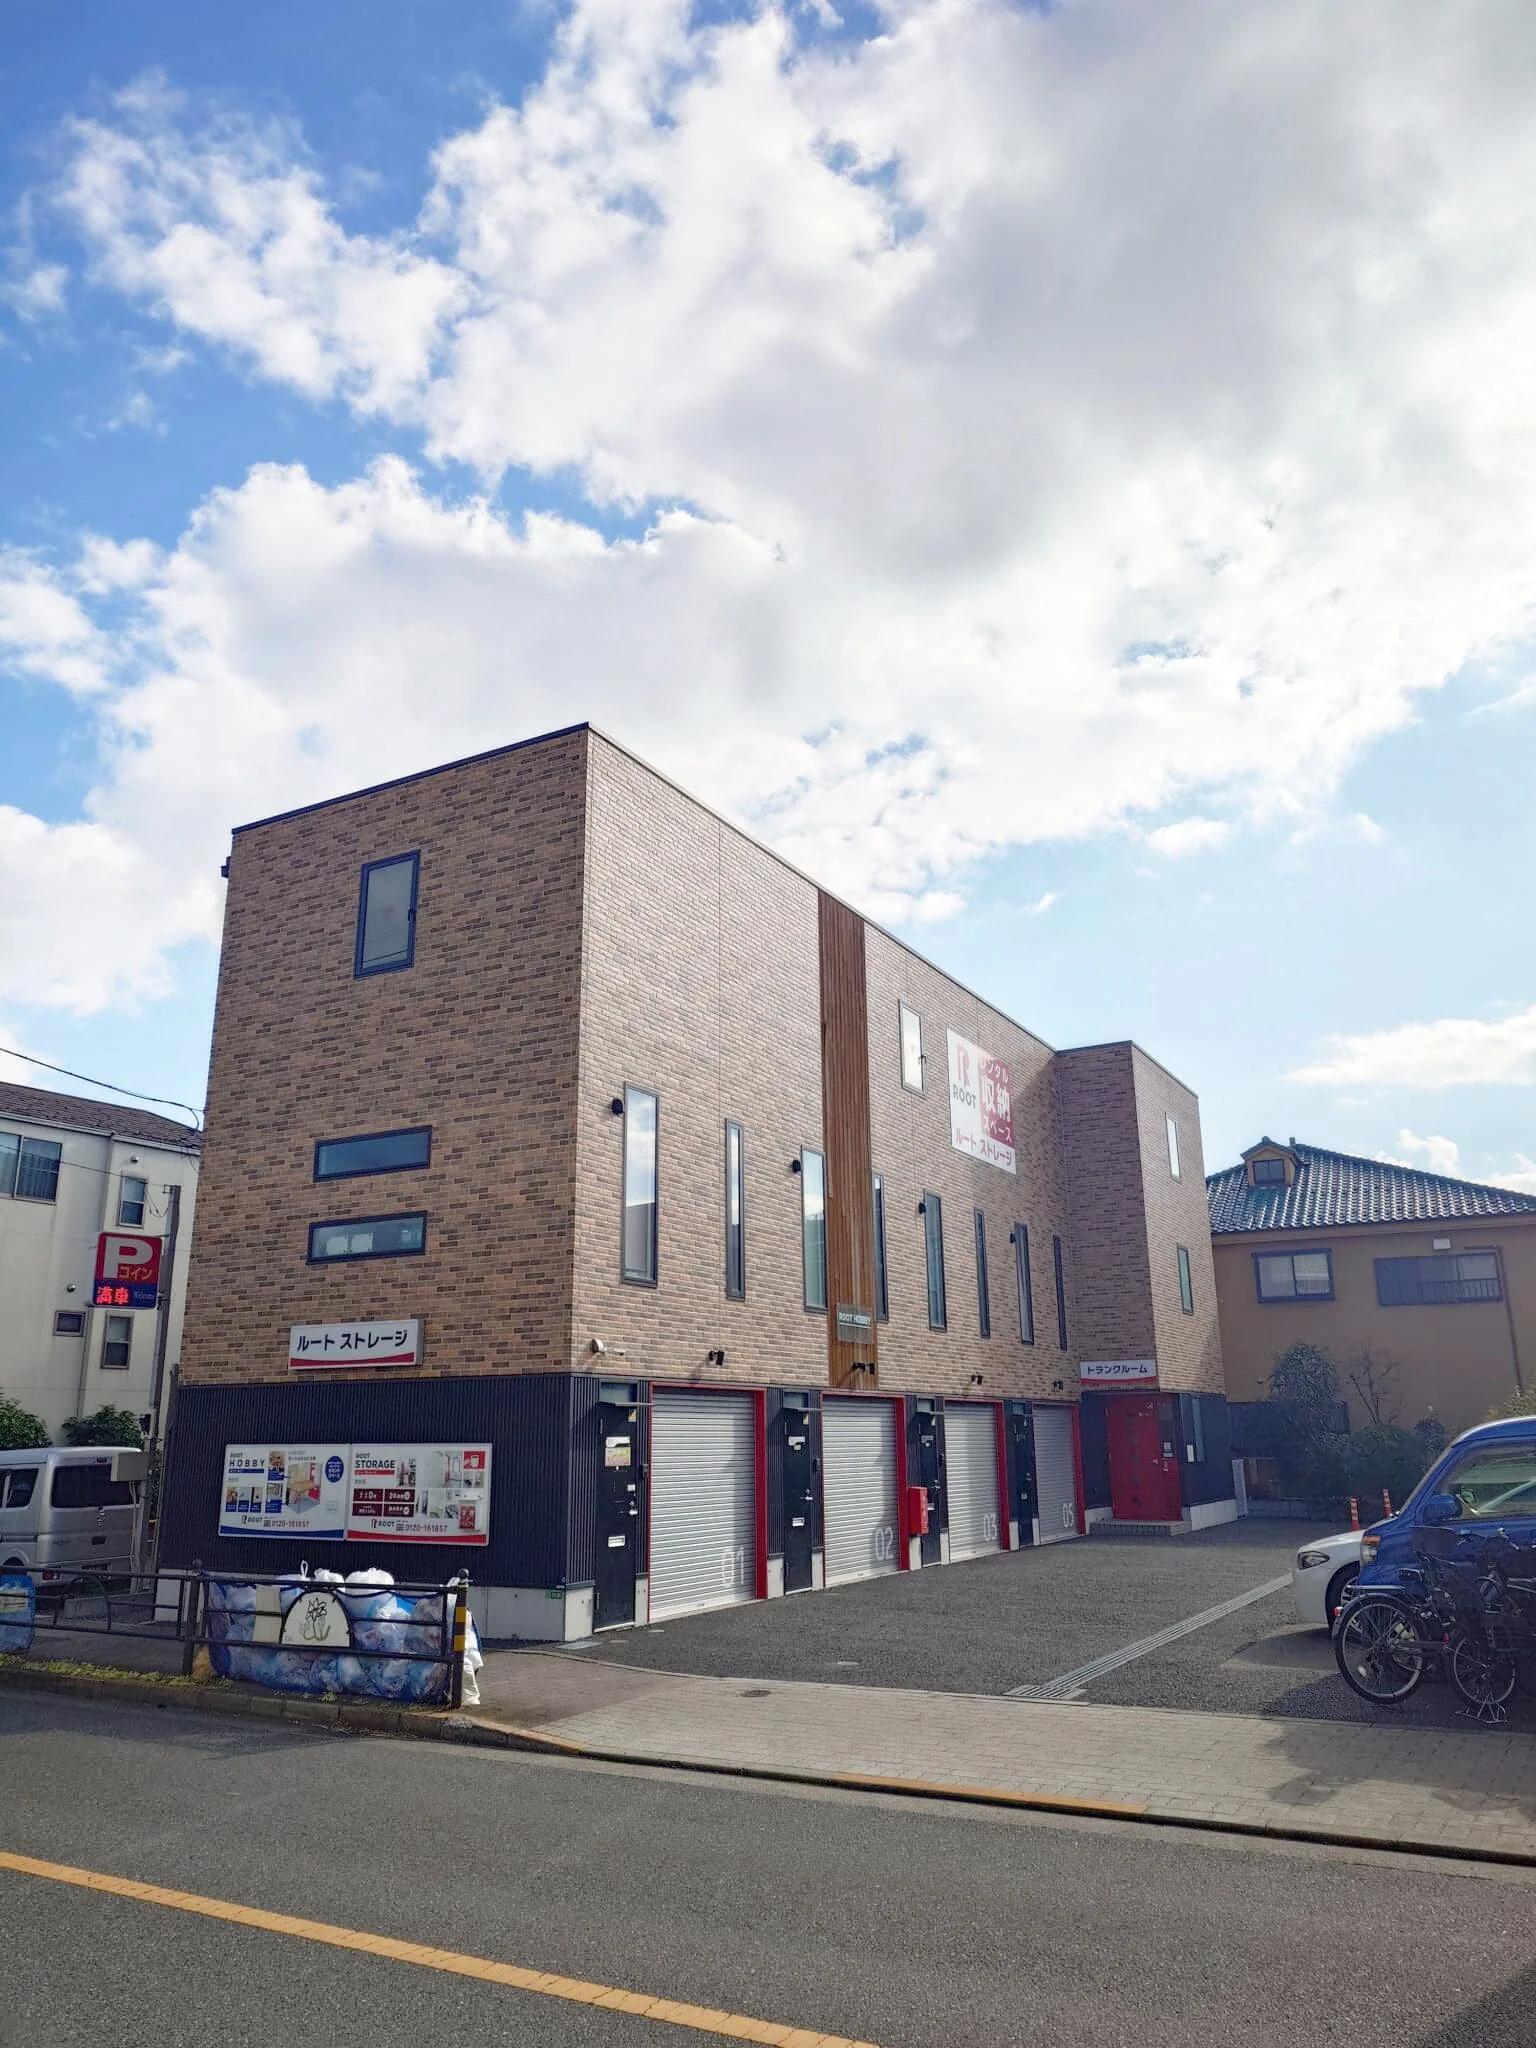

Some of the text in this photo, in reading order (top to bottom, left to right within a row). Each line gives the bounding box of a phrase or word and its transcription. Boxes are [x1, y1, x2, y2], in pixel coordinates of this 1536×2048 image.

[953, 1084, 976, 1109] ROOT
[981, 1075, 1010, 1122] 収納
[983, 1115, 1012, 1143] スペース
[956, 1128, 1012, 1166] ルート ストレージ
[103, 1236, 153, 1279] P
[119, 1266, 153, 1280] コイン
[96, 1286, 129, 1304] 満車
[297, 1329, 408, 1351] ルート ストレージ
[1087, 1364, 1148, 1374] トランクルーム
[229, 1459, 265, 1468] HOBBY
[354, 1460, 396, 1469] STORAGE
[405, 1523, 448, 1533] 0120-161857
[983, 1512, 998, 1541] 03
[1062, 1503, 1074, 1528] 05
[875, 1526, 895, 1562] 02
[722, 1546, 745, 1588] 01
